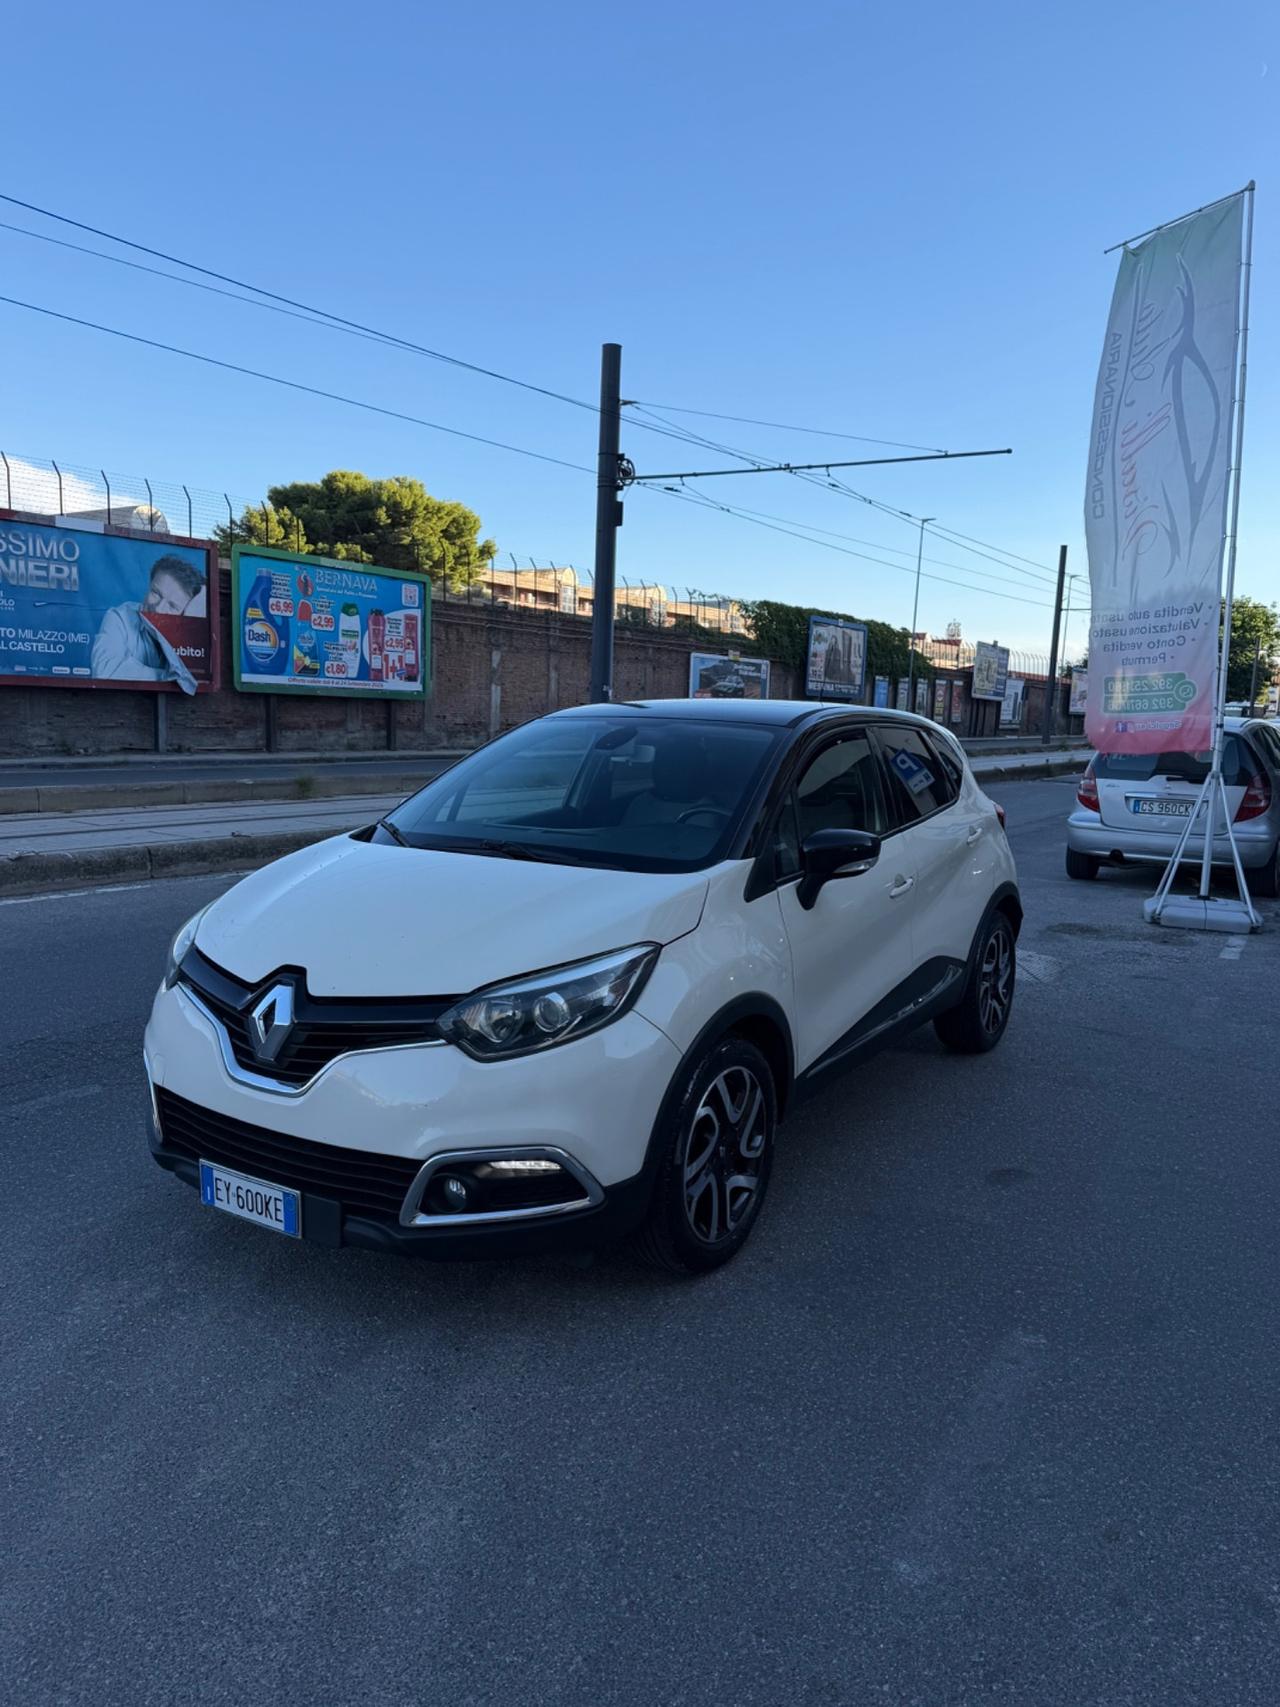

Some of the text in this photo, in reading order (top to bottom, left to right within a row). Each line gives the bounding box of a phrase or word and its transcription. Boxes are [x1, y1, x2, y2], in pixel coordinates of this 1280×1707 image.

[315, 568, 378, 592] BERNAVA
[18, 629, 67, 642] MILAZZO
[68, 632, 90, 644] (ME)
[248, 629, 272, 642] Dash
[9, 641, 65, 654] CASTELLO
[1140, 799, 1192, 815] CS 960CK
[215, 1177, 231, 1205] EY
[236, 1185, 283, 1223] 600KE
